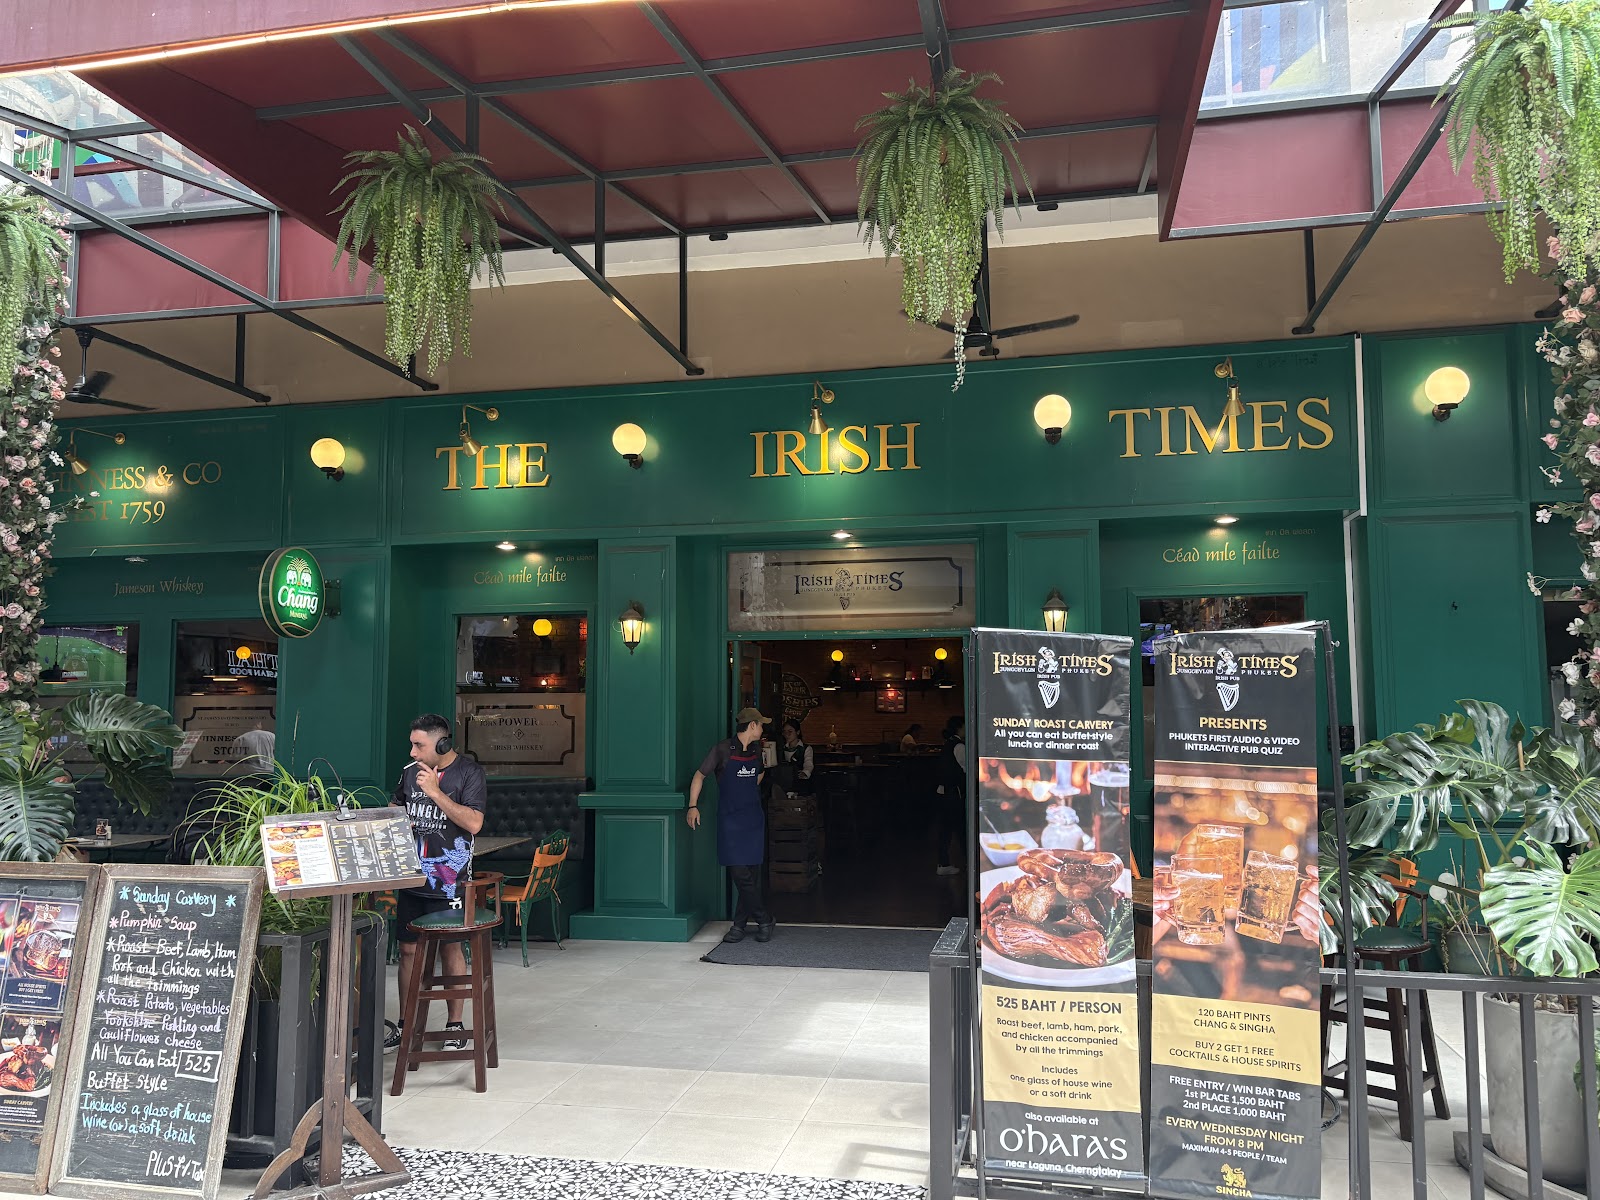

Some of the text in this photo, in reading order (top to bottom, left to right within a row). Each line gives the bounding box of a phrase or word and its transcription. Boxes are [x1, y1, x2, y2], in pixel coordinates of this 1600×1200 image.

[435, 396, 1335, 490] THE IRISH TIMES
[52, 461, 222, 492] INNESS & CO
[120, 500, 165, 524] 1759
[113, 576, 204, 598] Jameson Whiskey
[278, 585, 318, 615] Chang
[993, 718, 1114, 729] SUNDAY ROAST CARVERY
[1200, 717, 1267, 730] PRESENTS
[1008, 731, 1024, 739] you
[1045, 731, 1060, 739] eat
[1169, 733, 1300, 745] PHUKETS FIRST AUDIO & VIDEO
[1185, 743, 1283, 755] INTERACTIVE PUB QUIZ
[133, 886, 170, 912] Sunday
[119, 910, 197, 939] Pumpkin Soup
[215, 941, 236, 959] Ham
[112, 954, 235, 978] Pork and Chicken with
[107, 988, 140, 1007] Roast
[181, 998, 230, 1018] vegetables
[996, 996, 1121, 1014] 525 BAHT PERSON
[1198, 1008, 1271, 1022] 120 BAHT PINTS
[997, 1018, 1122, 1034] Roast beef, lamb, ham, pork,
[1194, 1019, 1276, 1034] CHANG & SINGHA
[165, 1032, 203, 1050] cheese
[1001, 1031, 1118, 1045] and chicken accompanied
[91, 1041, 213, 1073] All You Can Eat 525
[1016, 1044, 1103, 1058] by all the trimmings
[1195, 1040, 1274, 1057] BUY 2 GET 1 FREE
[1169, 1048, 1301, 1072] COCKTAILS & HOUSE SPIRITS
[136, 1074, 168, 1094] Style
[1170, 1076, 1301, 1101] FREE ENTRY WIN BAR TABS
[80, 1093, 127, 1114] Includes
[131, 1104, 140, 1115] a
[142, 1102, 169, 1120] glass
[183, 1103, 212, 1123] house
[1185, 1089, 1285, 1110] 1st PLACE 1,500 BAHT
[1025, 1112, 1099, 1126] also available at
[1183, 1100, 1286, 1122] 2nd PLACE 1,000 BAHT
[82, 1113, 108, 1129] Wine
[139, 1119, 161, 1136] soft
[164, 1121, 196, 1145] drink
[1166, 1116, 1304, 1145] EVERY WEDNESDAY NIGHT
[1204, 1134, 1264, 1151] FROM 8 PM
[1182, 1143, 1287, 1164] MAXIMUM 4-5 PEOPLE TEAM
[1005, 1159, 1027, 1168] near
[1029, 1159, 1063, 1172] Laguna,
[1216, 1185, 1252, 1198] SINGHA
